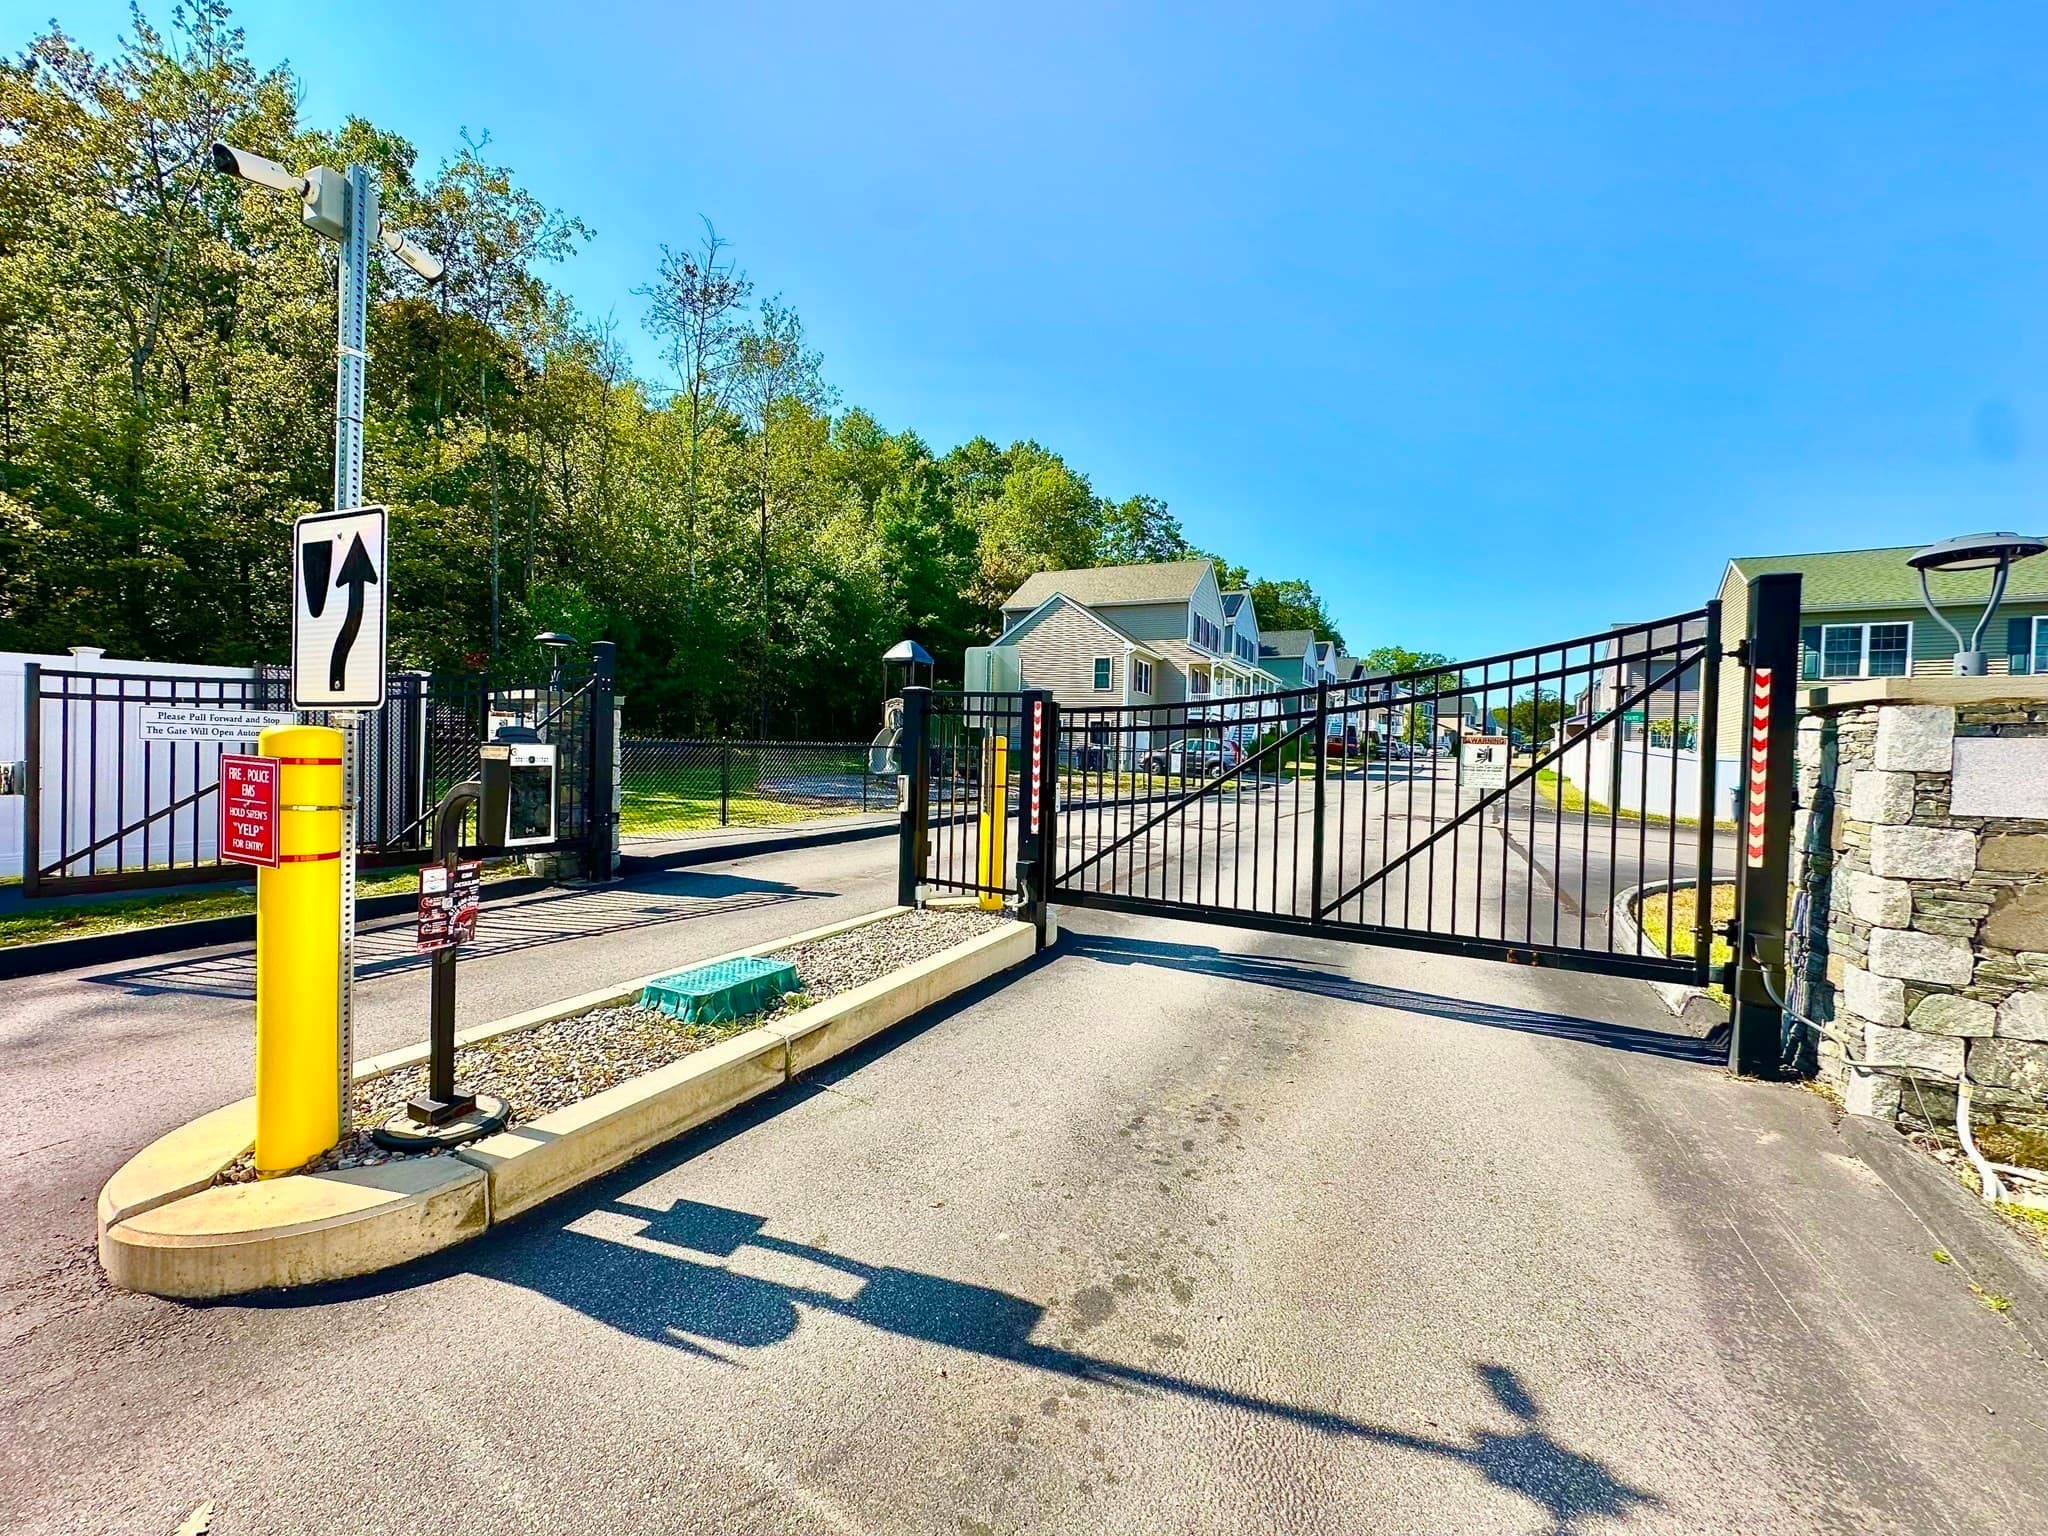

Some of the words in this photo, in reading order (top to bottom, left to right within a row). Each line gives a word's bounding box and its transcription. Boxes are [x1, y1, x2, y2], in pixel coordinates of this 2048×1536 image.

[158, 711, 186, 721] Please
[189, 713, 206, 722] Pull
[210, 715, 242, 723] Forward
[263, 717, 280, 725] Stop
[146, 726, 163, 735] The
[167, 726, 187, 736] Gate
[190, 727, 209, 736] Will
[212, 728, 234, 738] Open
[229, 767, 241, 780] FIRE
[248, 769, 269, 783] POLICE
[242, 784, 255, 796] EMS
[230, 807, 245, 816] HOLD
[233, 838, 244, 848] FOR
[245, 840, 264, 852] ENTRY
